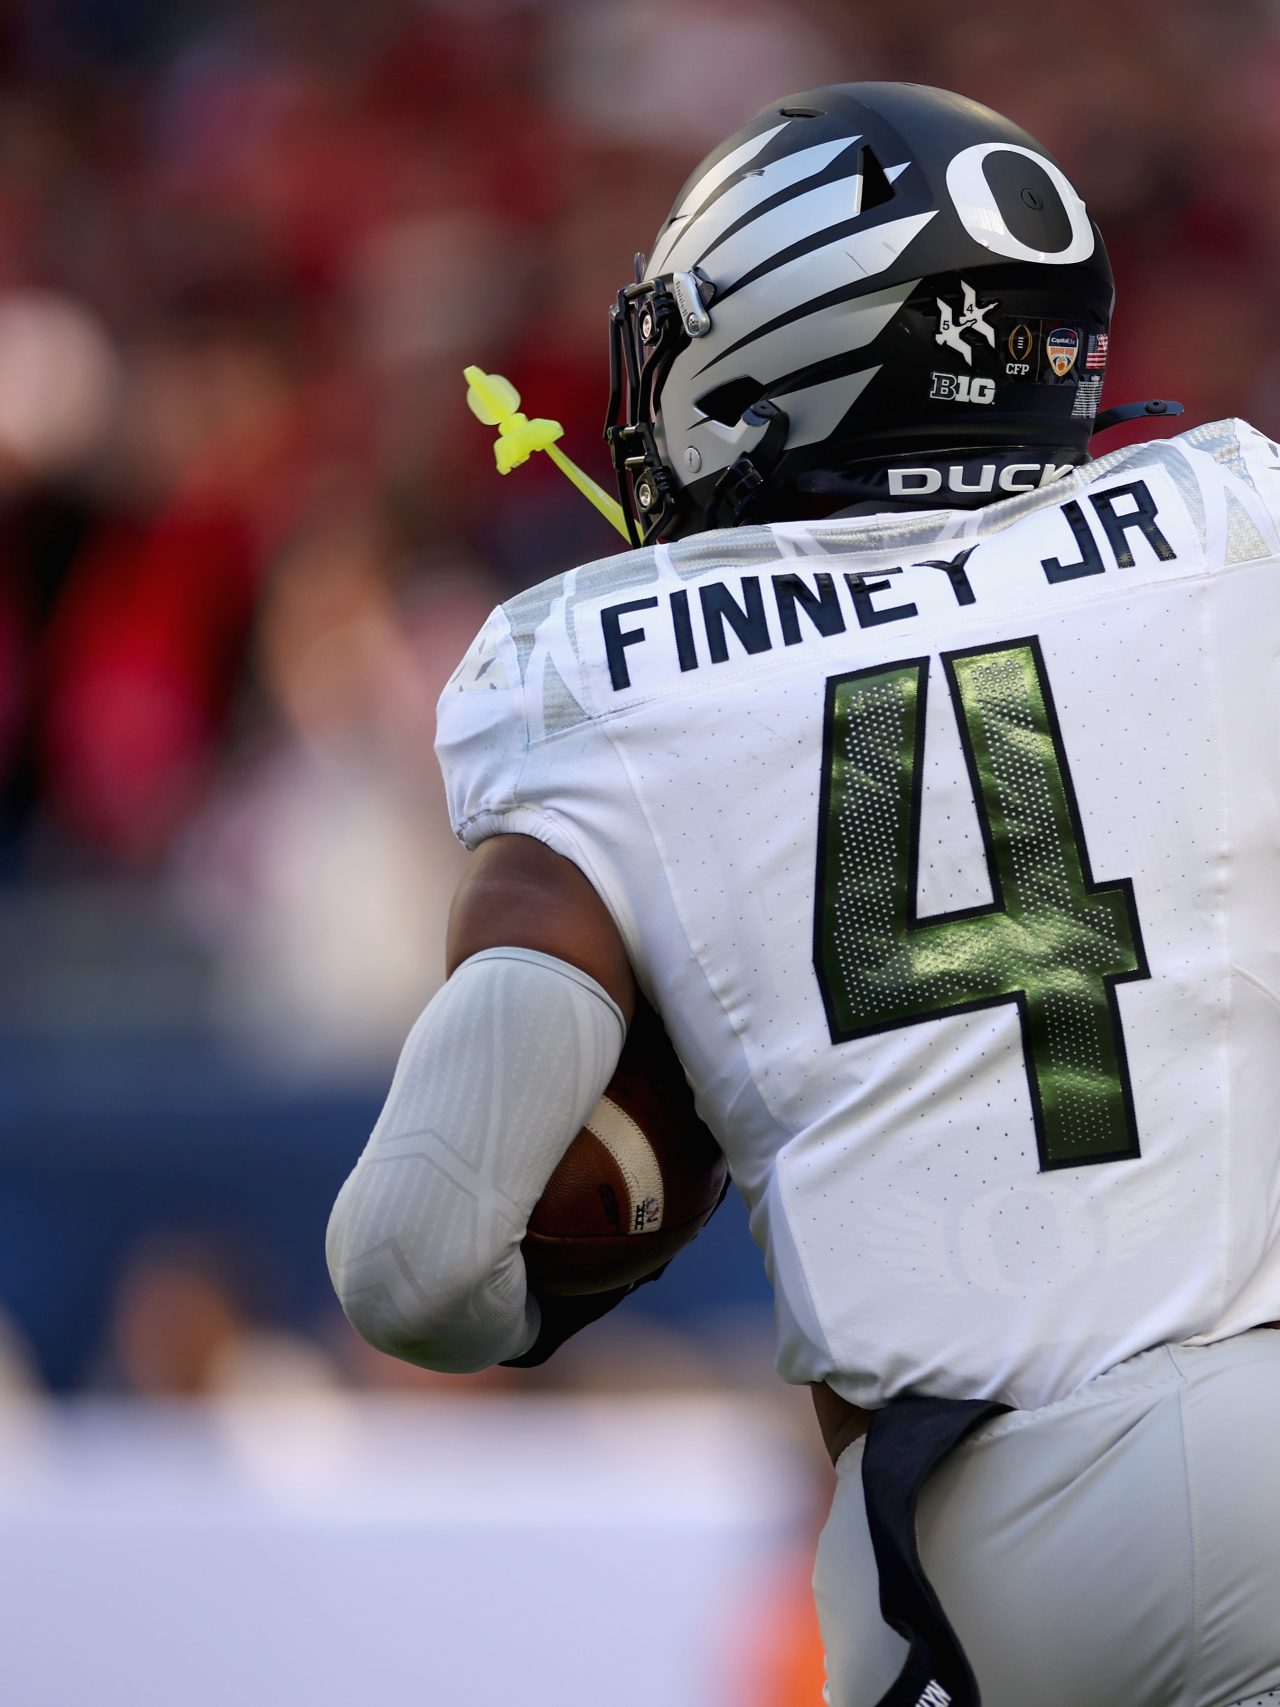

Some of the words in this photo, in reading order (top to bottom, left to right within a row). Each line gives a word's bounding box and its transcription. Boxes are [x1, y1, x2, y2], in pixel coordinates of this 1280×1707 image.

[966, 303, 974, 313] 4
[942, 320, 950, 331] 5
[1005, 362, 1030, 376] CFP
[600, 543, 980, 691] FINNEY
[1041, 480, 1177, 584] JR
[813, 635, 1152, 1172] 4
